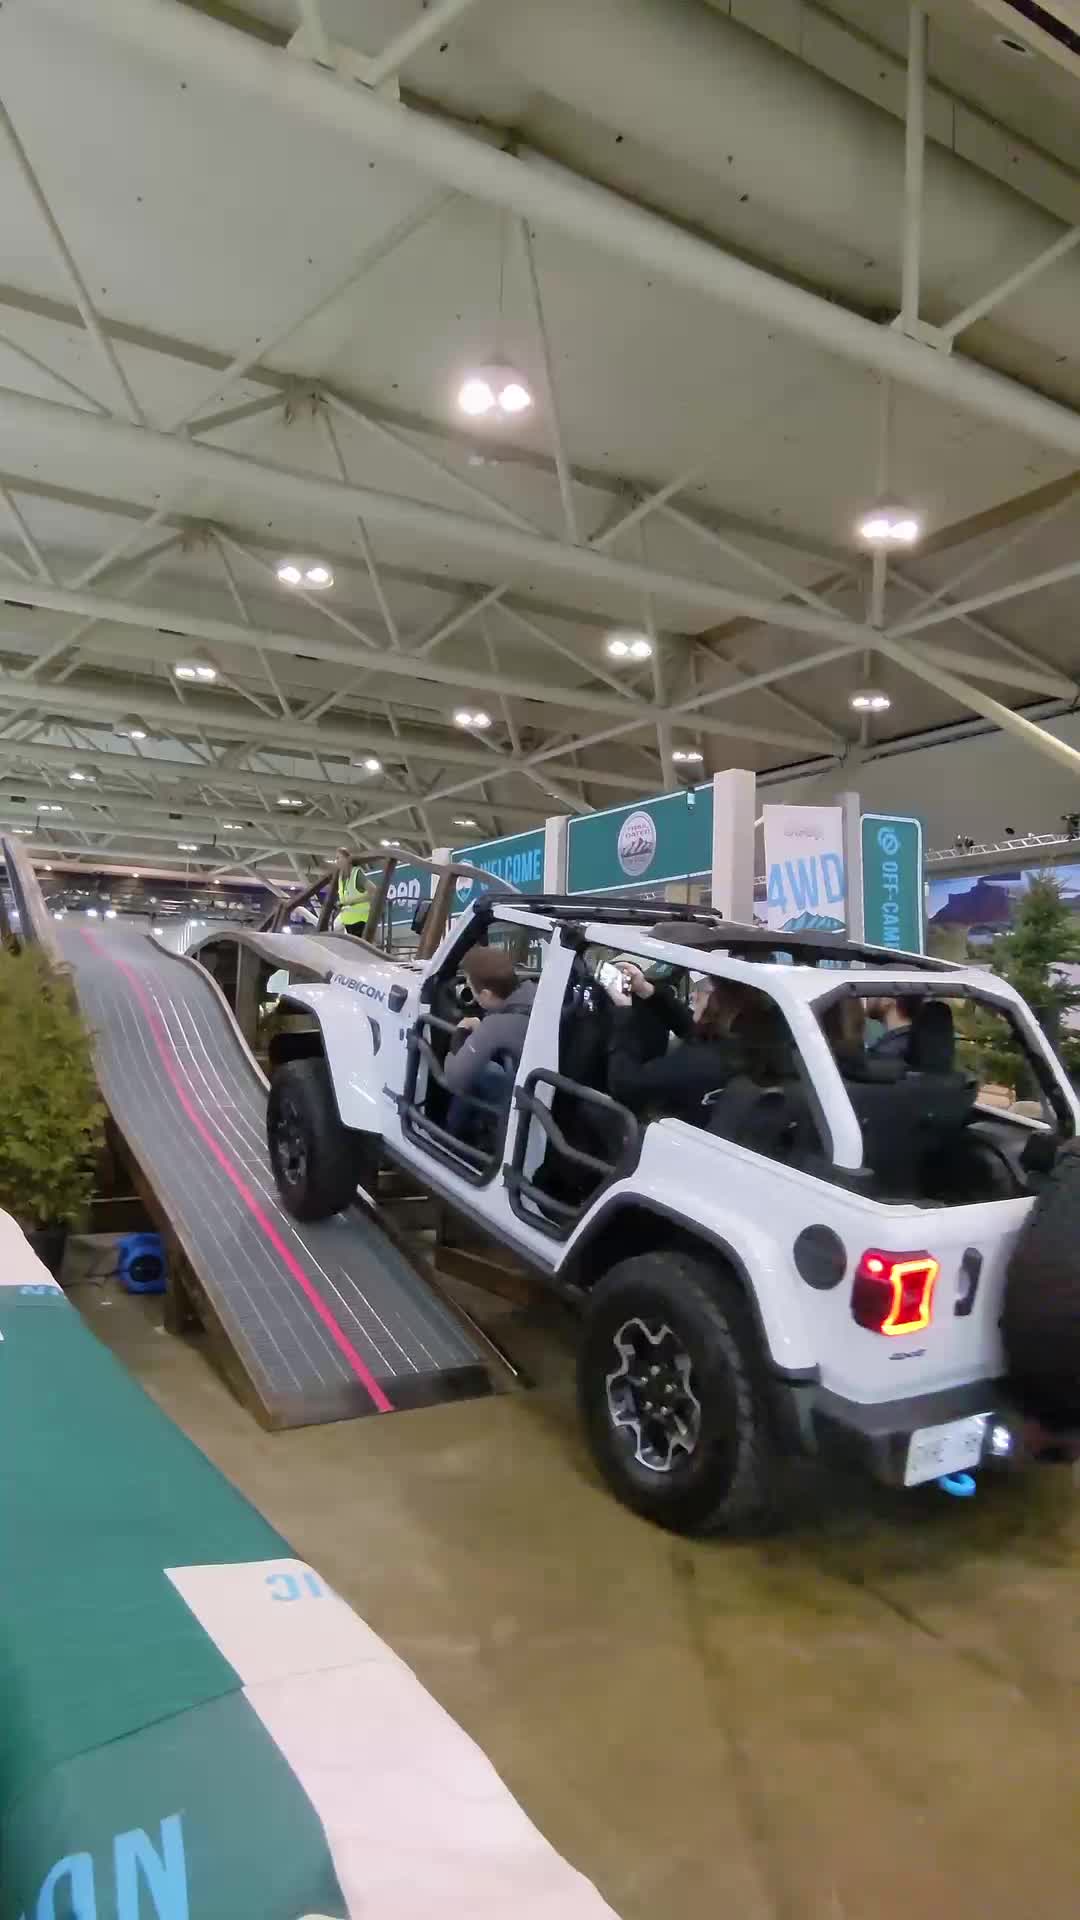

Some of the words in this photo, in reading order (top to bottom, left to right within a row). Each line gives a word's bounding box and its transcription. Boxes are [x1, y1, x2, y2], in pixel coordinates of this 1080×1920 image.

[480, 849, 541, 891] WELCOME
[768, 853, 847, 913] 4WD
[386, 878, 421, 908] eep
[334, 974, 385, 1002] RUBICON
[18, 1813, 190, 1920] ND
